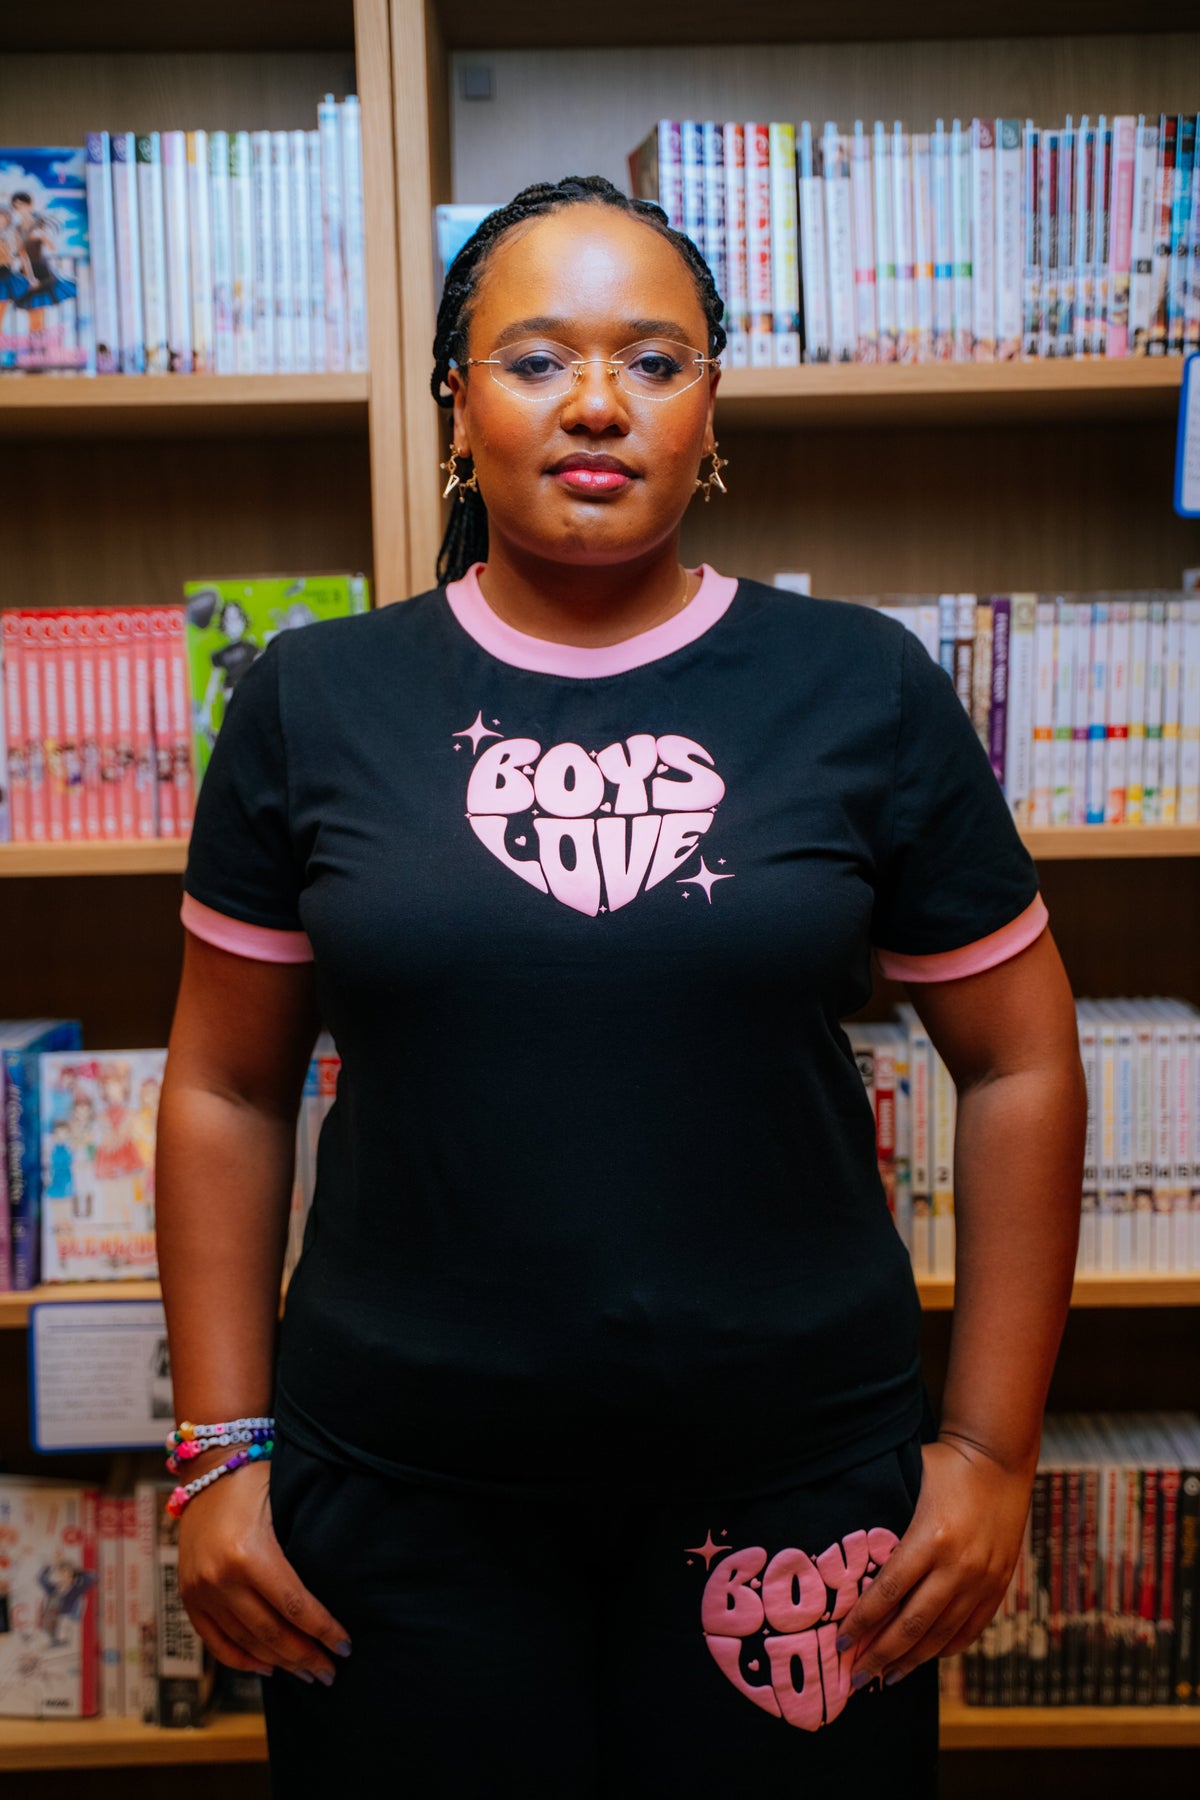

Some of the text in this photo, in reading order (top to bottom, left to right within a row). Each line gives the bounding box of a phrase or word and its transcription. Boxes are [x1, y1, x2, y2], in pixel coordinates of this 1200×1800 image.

[467, 734, 725, 817] BOYS
[469, 812, 714, 917] LOVE
[938, 1166, 949, 1183] 2
[705, 1622, 858, 1732] LOV
